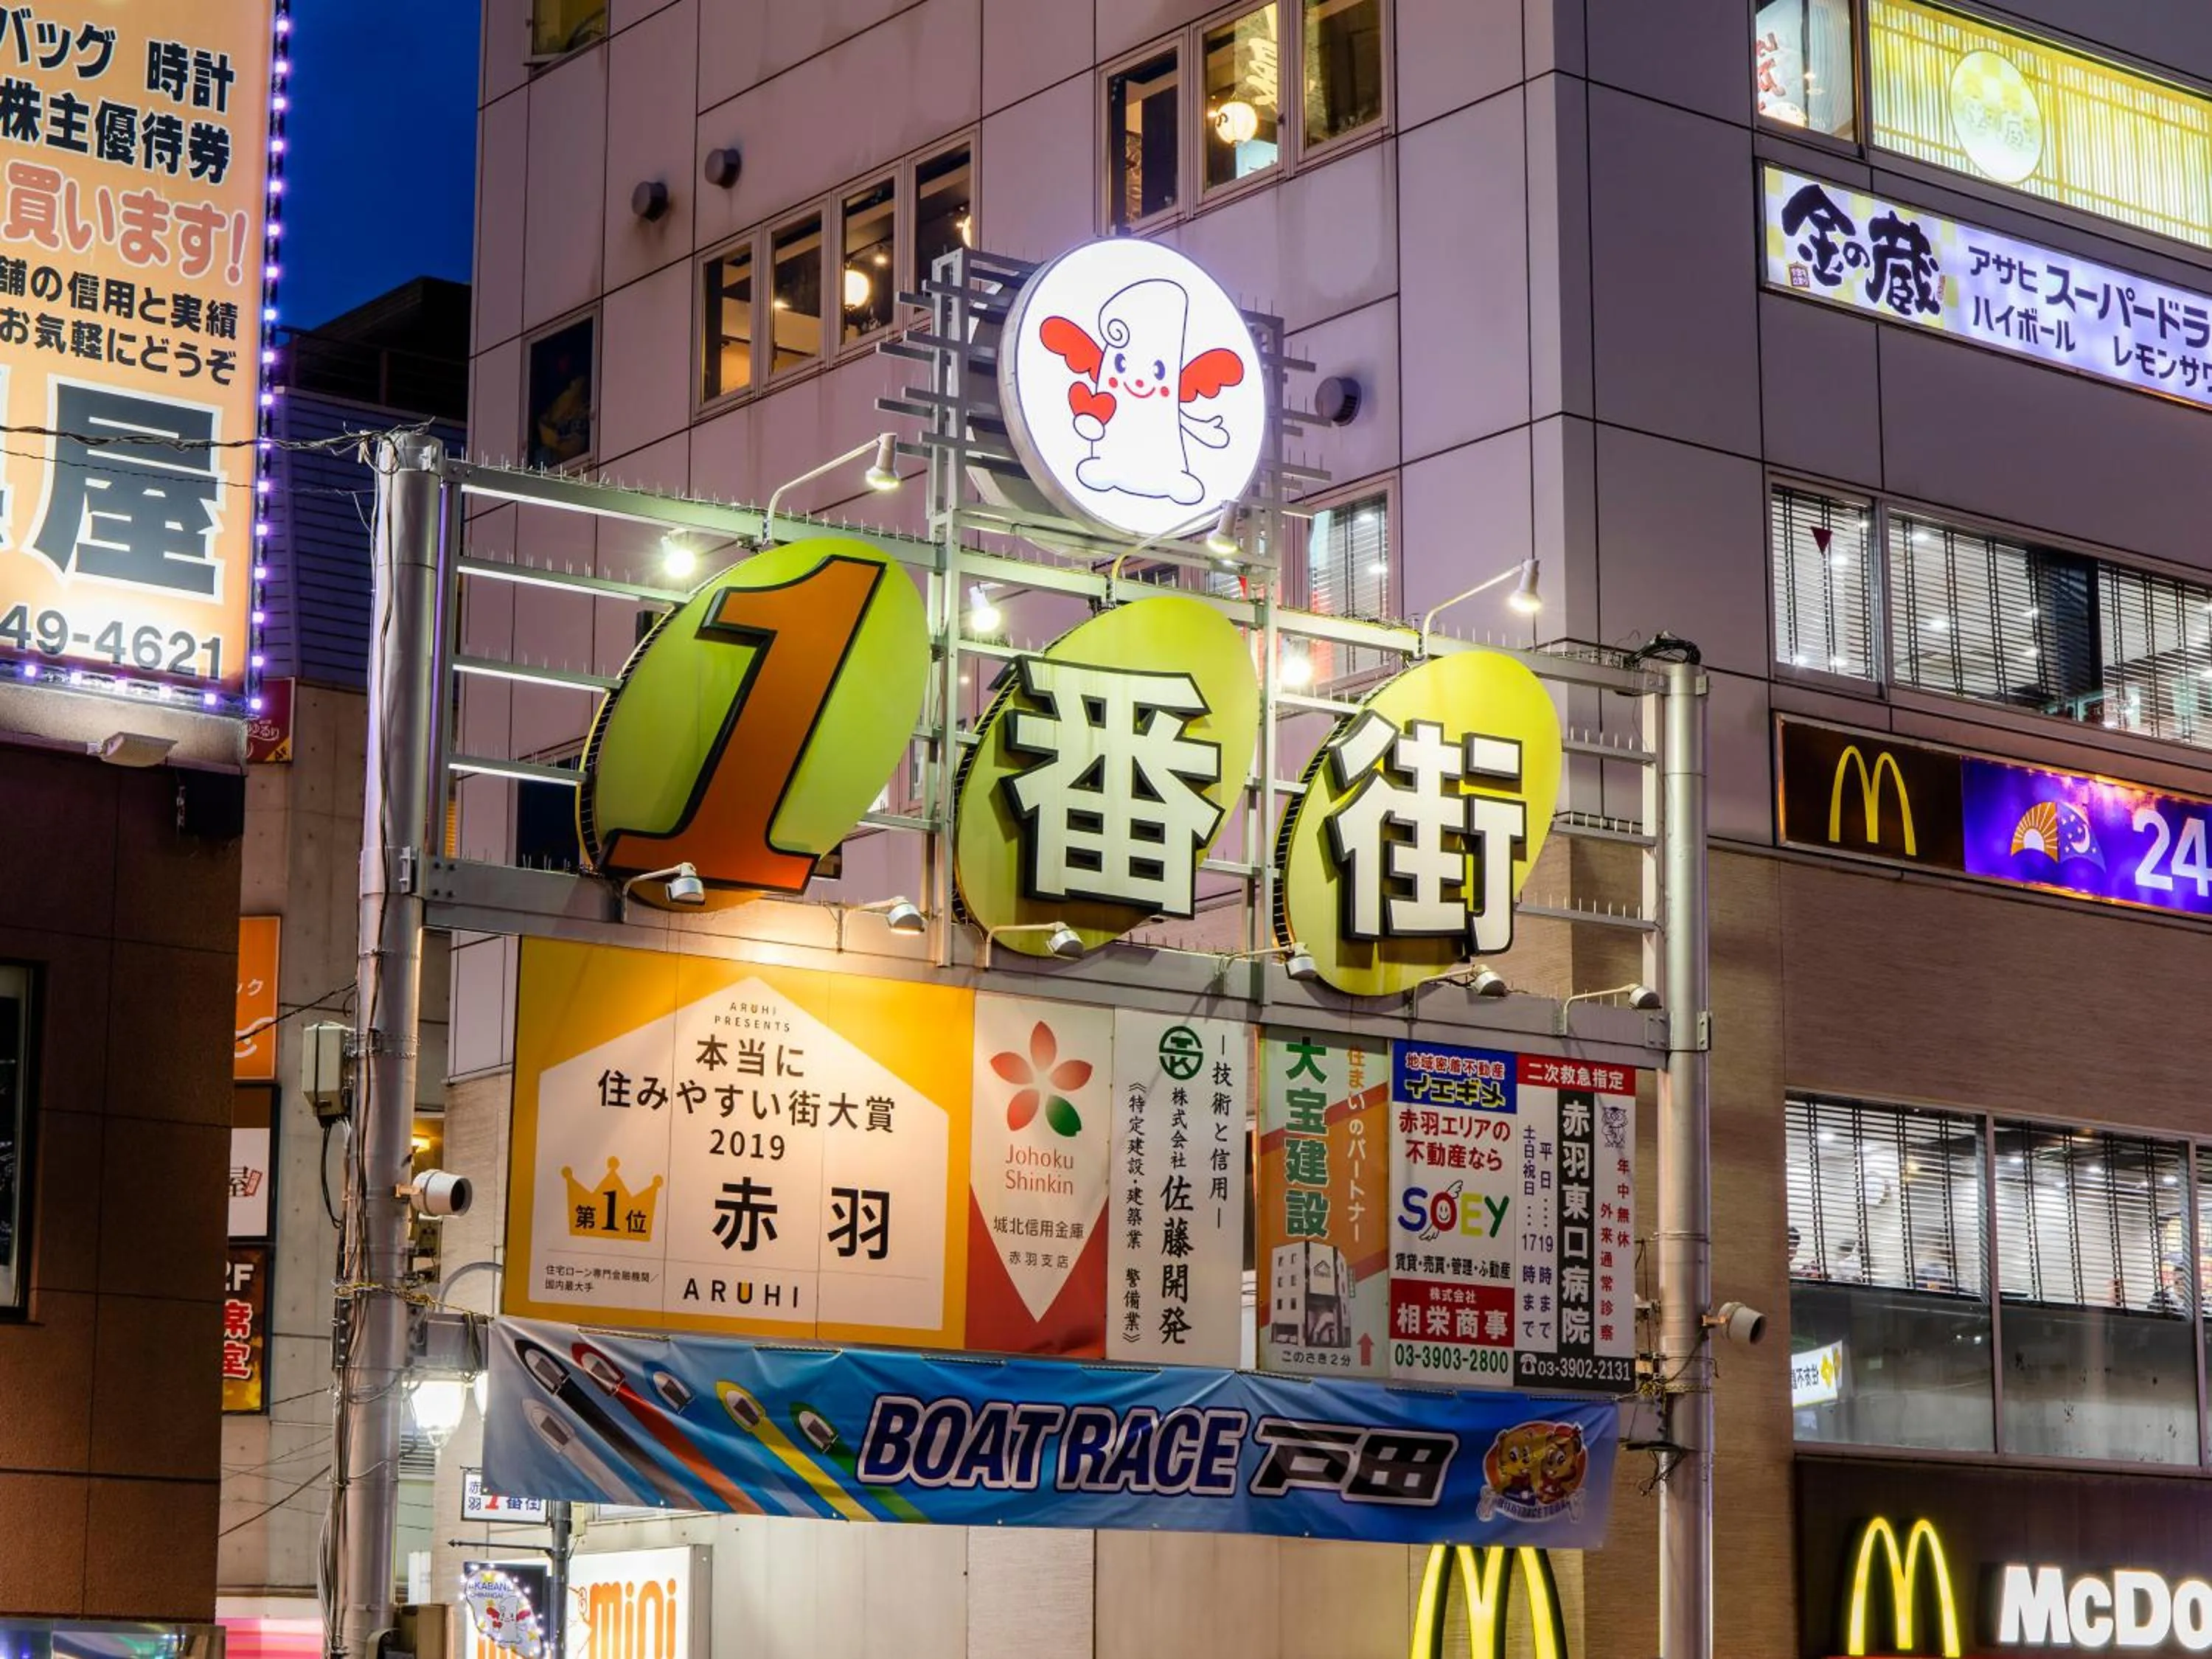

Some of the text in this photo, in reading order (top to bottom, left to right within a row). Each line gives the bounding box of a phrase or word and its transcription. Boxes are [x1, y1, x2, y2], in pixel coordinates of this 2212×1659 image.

[0, 7, 235, 113] バッグ 時計
[0, 78, 232, 184] 株主優待券
[1781, 184, 1941, 316] 金の蔵
[1972, 296, 2076, 352] ハイボール
[0, 307, 237, 386] お気軽にどうぞ
[0, 374, 223, 599] 屋
[2132, 809, 2212, 897] 24
[714, 1015, 790, 1033] PRESENTS
[729, 1001, 777, 1016] ARUHI
[695, 1034, 805, 1078] 本当に
[1405, 1051, 1505, 1079] 地域密着不動産
[1404, 1073, 1506, 1107] イエギメ
[1527, 1062, 1625, 1090] 二次救急指定
[597, 1068, 895, 1134] 住みやすい街大賞
[1284, 1035, 1330, 1238] 大宝建設
[1399, 1108, 1511, 1142] 赤羽エリアの
[709, 1128, 786, 1161] 2019
[1004, 1143, 1074, 1170] Johoku
[1405, 1138, 1502, 1172] 不動産なら
[1004, 1169, 1074, 1196] Shinkin
[574, 1189, 647, 1234] 第1位
[1397, 1186, 1510, 1238] SOEY
[1616, 1158, 1631, 1248] 年中無休
[993, 1214, 1085, 1240] 城北信用金庫
[1560, 1102, 1591, 1345] 赤羽東口病院
[1007, 1250, 1069, 1269] 赤羽支店
[1600, 1203, 1615, 1341] 外来通常診察
[545, 1279, 594, 1293] 国内最大手
[683, 1278, 799, 1308] ARUHI
[1429, 1286, 1477, 1304] 株式会社
[1397, 1301, 1509, 1340] 相栄商事
[1281, 1351, 1352, 1368] このさき2分
[1394, 1343, 1509, 1374] 03-3903-2800
[1537, 1355, 1632, 1382] 03-3902-2131
[857, 1394, 1461, 1509] BOAT RACE 戸田
